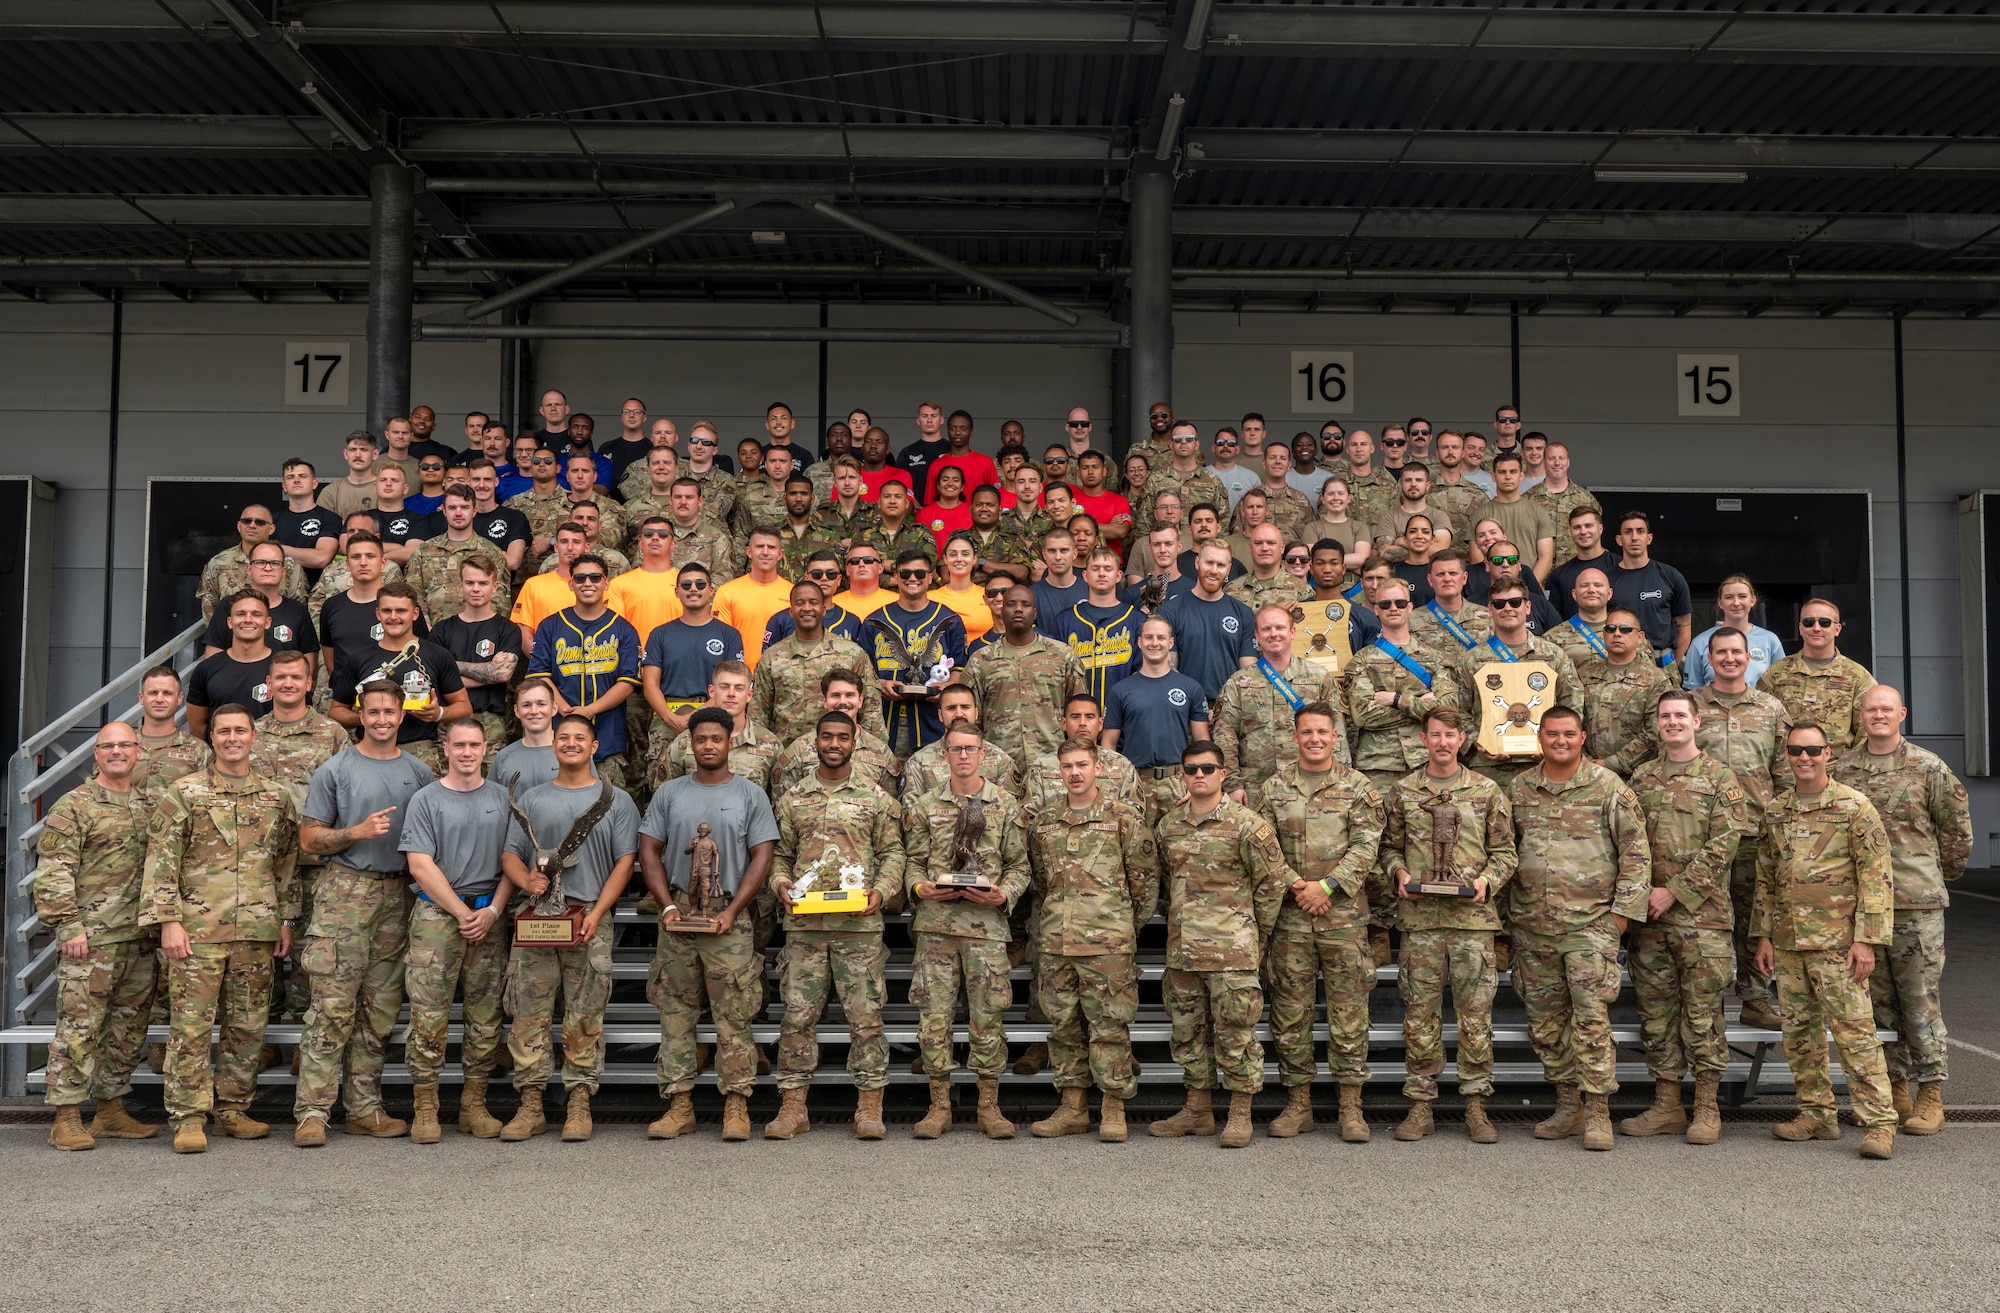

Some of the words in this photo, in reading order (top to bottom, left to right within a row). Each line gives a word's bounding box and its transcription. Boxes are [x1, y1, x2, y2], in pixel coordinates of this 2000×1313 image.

[294, 354, 341, 393] 17
[1298, 362, 1345, 402] 16
[1684, 365, 1732, 405] 15
[556, 637, 583, 664] Damn
[585, 634, 620, 663] Straight
[1096, 625, 1130, 655] Straight
[1727, 789, 1743, 800] MX
